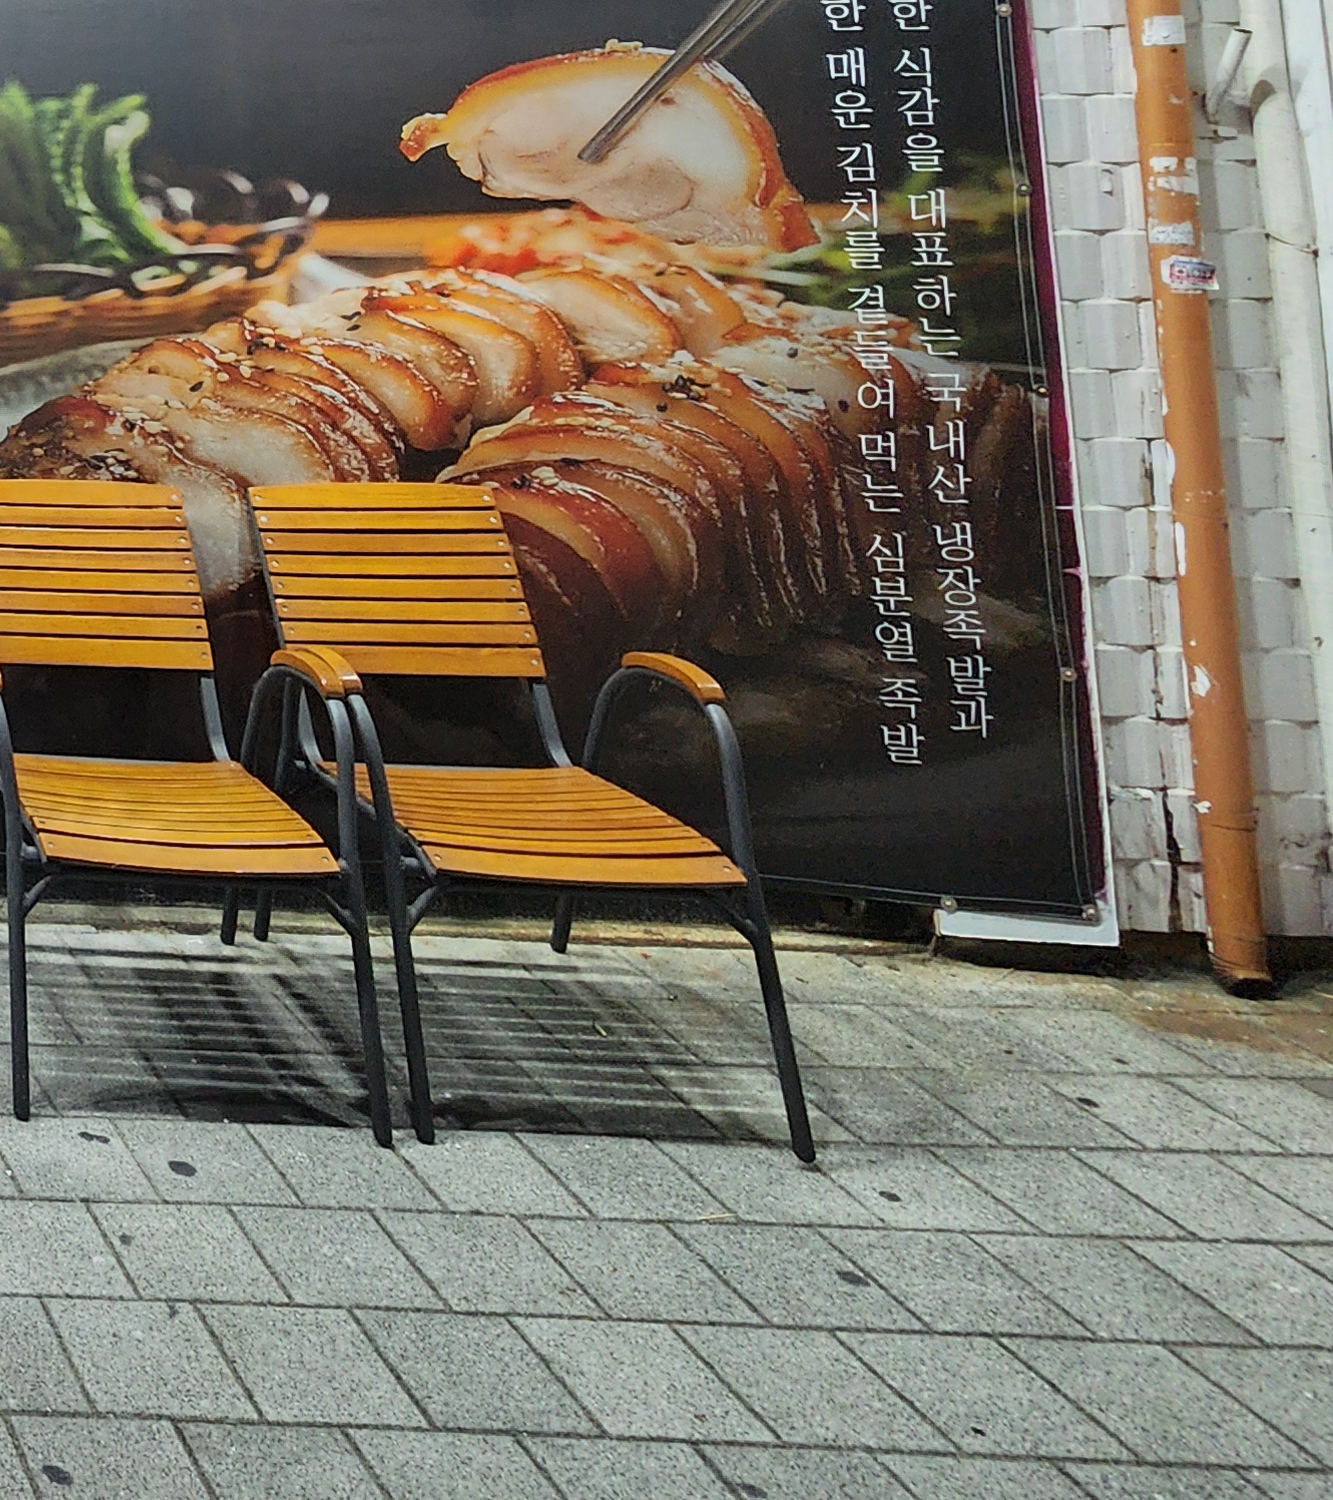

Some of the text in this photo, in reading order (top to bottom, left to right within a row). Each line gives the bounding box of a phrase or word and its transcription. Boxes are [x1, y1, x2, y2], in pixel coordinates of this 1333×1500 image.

[825, 46, 875, 130] 매운
[893, 47, 946, 172] 식감을
[836, 141, 886, 270] 김치를
[906, 187, 962, 358] 대표하는
[847, 284, 895, 420] 곁들여
[857, 430, 904, 514] 먹는
[924, 372, 973, 505] 국내산
[865, 531, 919, 663] 심분열
[878, 677, 927, 766] 족발
